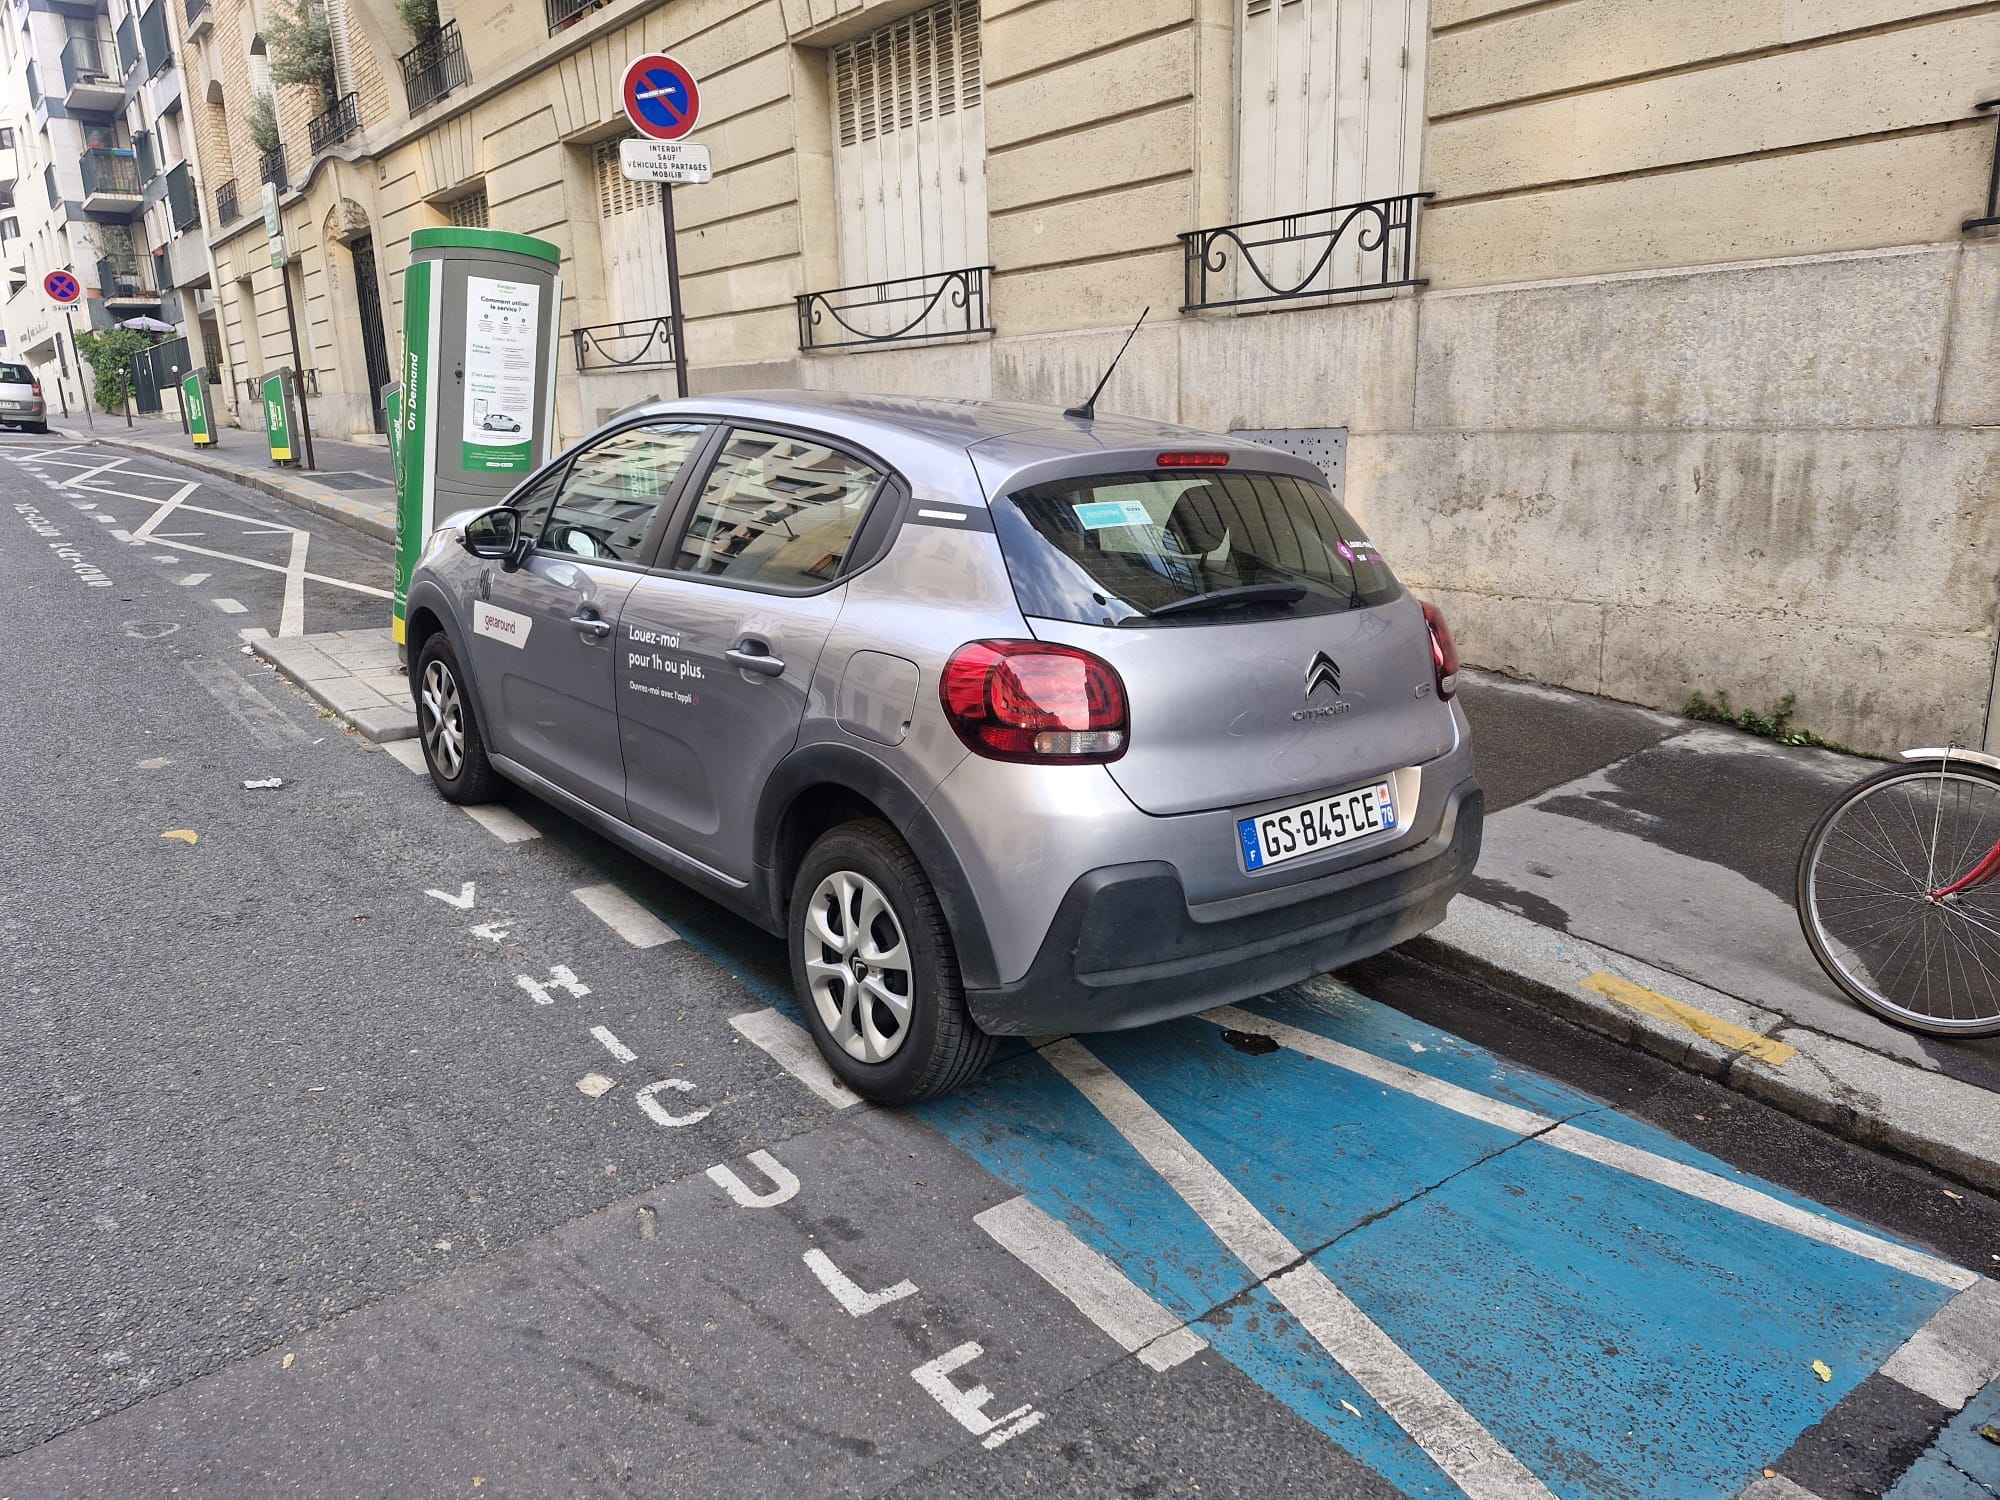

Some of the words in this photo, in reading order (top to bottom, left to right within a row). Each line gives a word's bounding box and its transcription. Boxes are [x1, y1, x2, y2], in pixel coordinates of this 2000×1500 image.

[649, 145, 682, 153] INTERDIT
[627, 160, 668, 169] VÉHICULES
[671, 162, 708, 172] PARTAGÉS
[480, 295, 511, 306] Comment
[497, 305, 518, 313] service
[408, 351, 419, 405] Demand
[408, 413, 416, 432] On
[484, 615, 516, 634] getaround
[629, 624, 681, 648] Louez-moi
[629, 652, 650, 669] pour
[651, 653, 663, 670] 1h
[664, 660, 678, 673] ou
[680, 659, 705, 680] plus.
[629, 680, 660, 695] Ouvrez-moi
[660, 689, 674, 699] avec
[1249, 850, 1256, 862] F
[1382, 806, 1394, 824] 78
